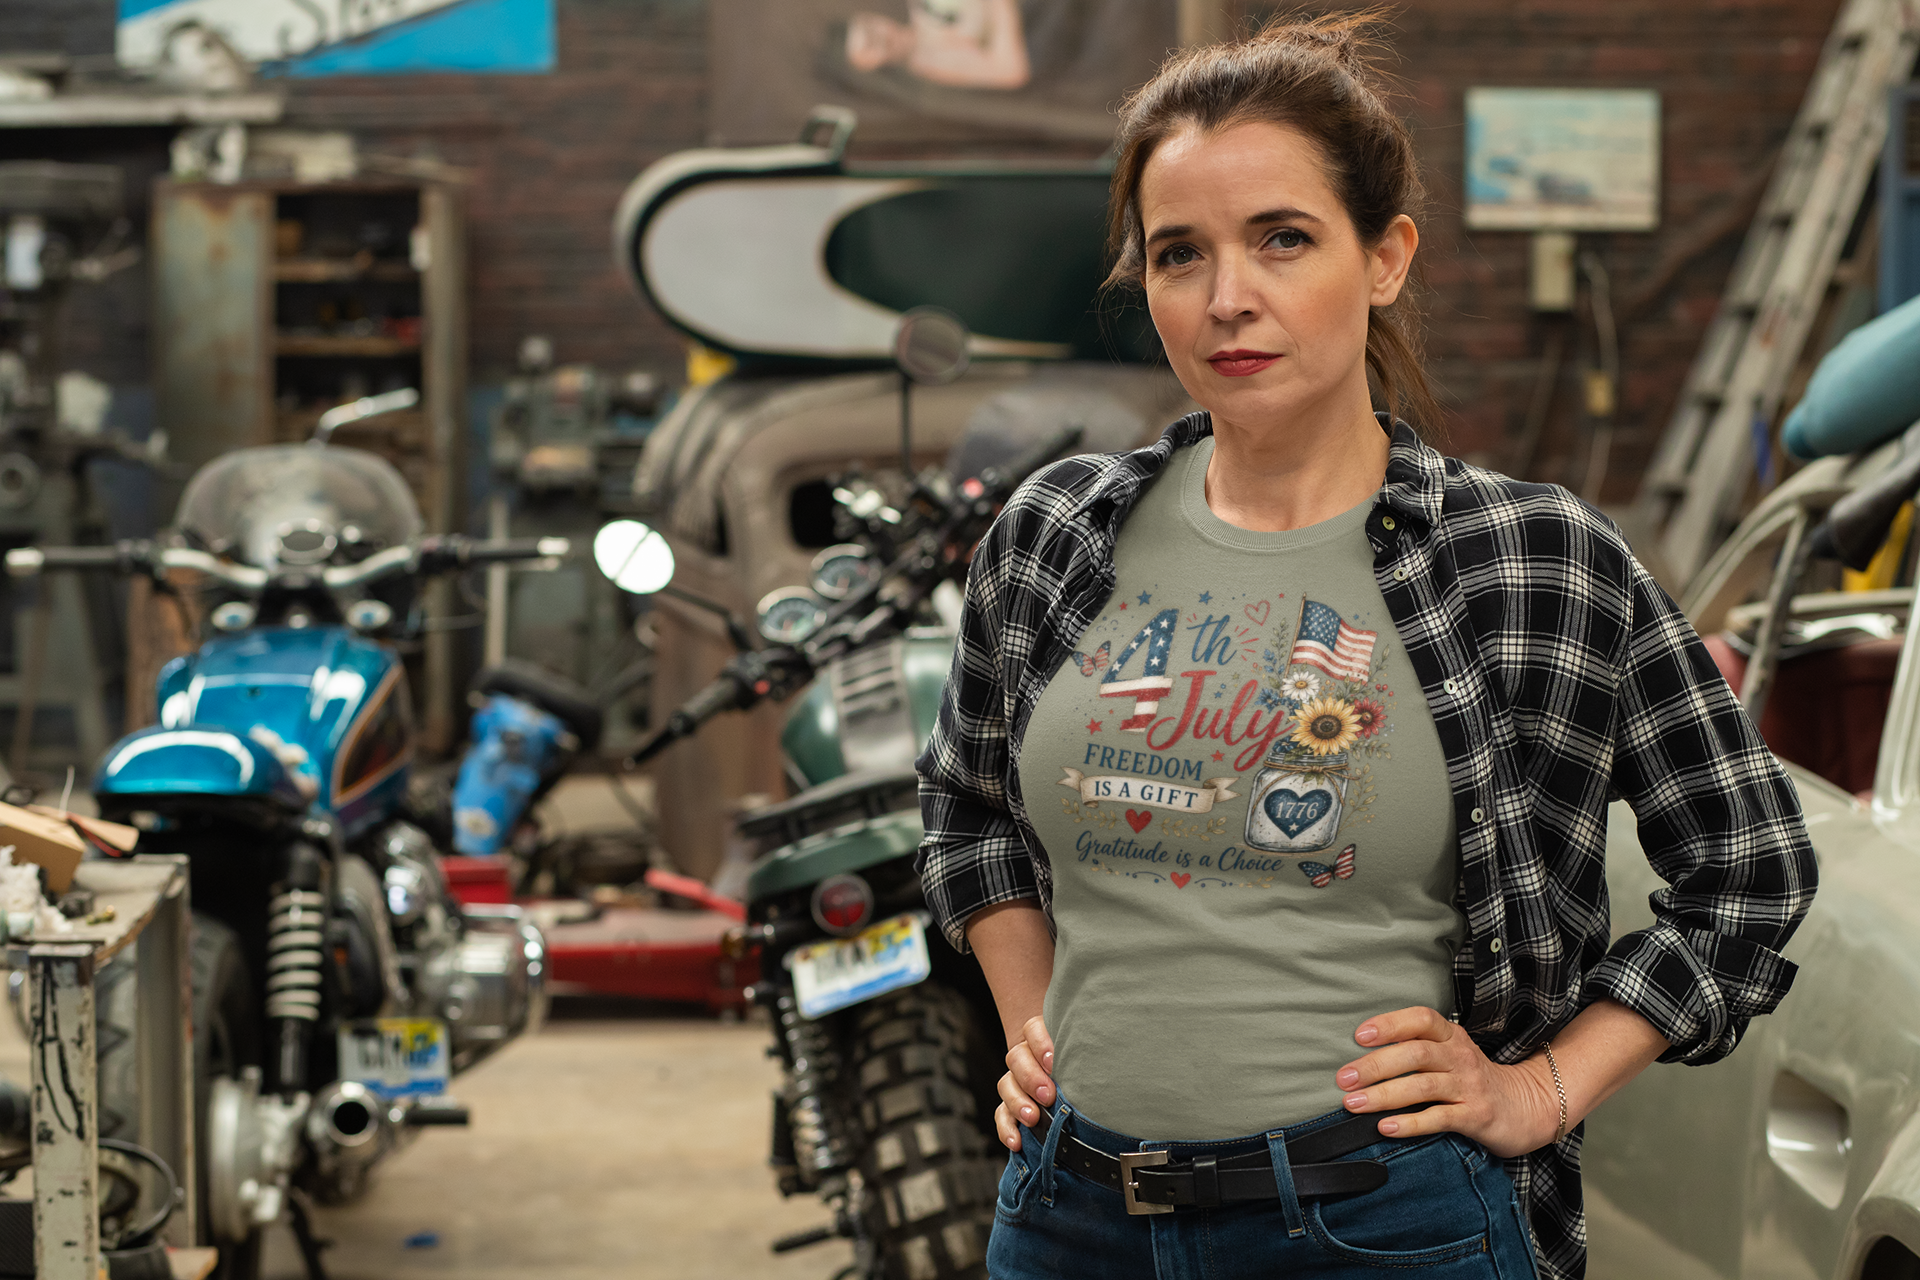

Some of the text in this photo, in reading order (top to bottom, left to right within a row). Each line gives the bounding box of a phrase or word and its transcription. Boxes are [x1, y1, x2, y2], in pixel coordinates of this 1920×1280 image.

[1146, 670, 1295, 772] July
[1083, 743, 1204, 781] FREEDOM
[1094, 780, 1199, 808] IS A GIFT
[1275, 801, 1319, 820] 1776
[1076, 830, 1285, 872] Gratitude is a Choice
